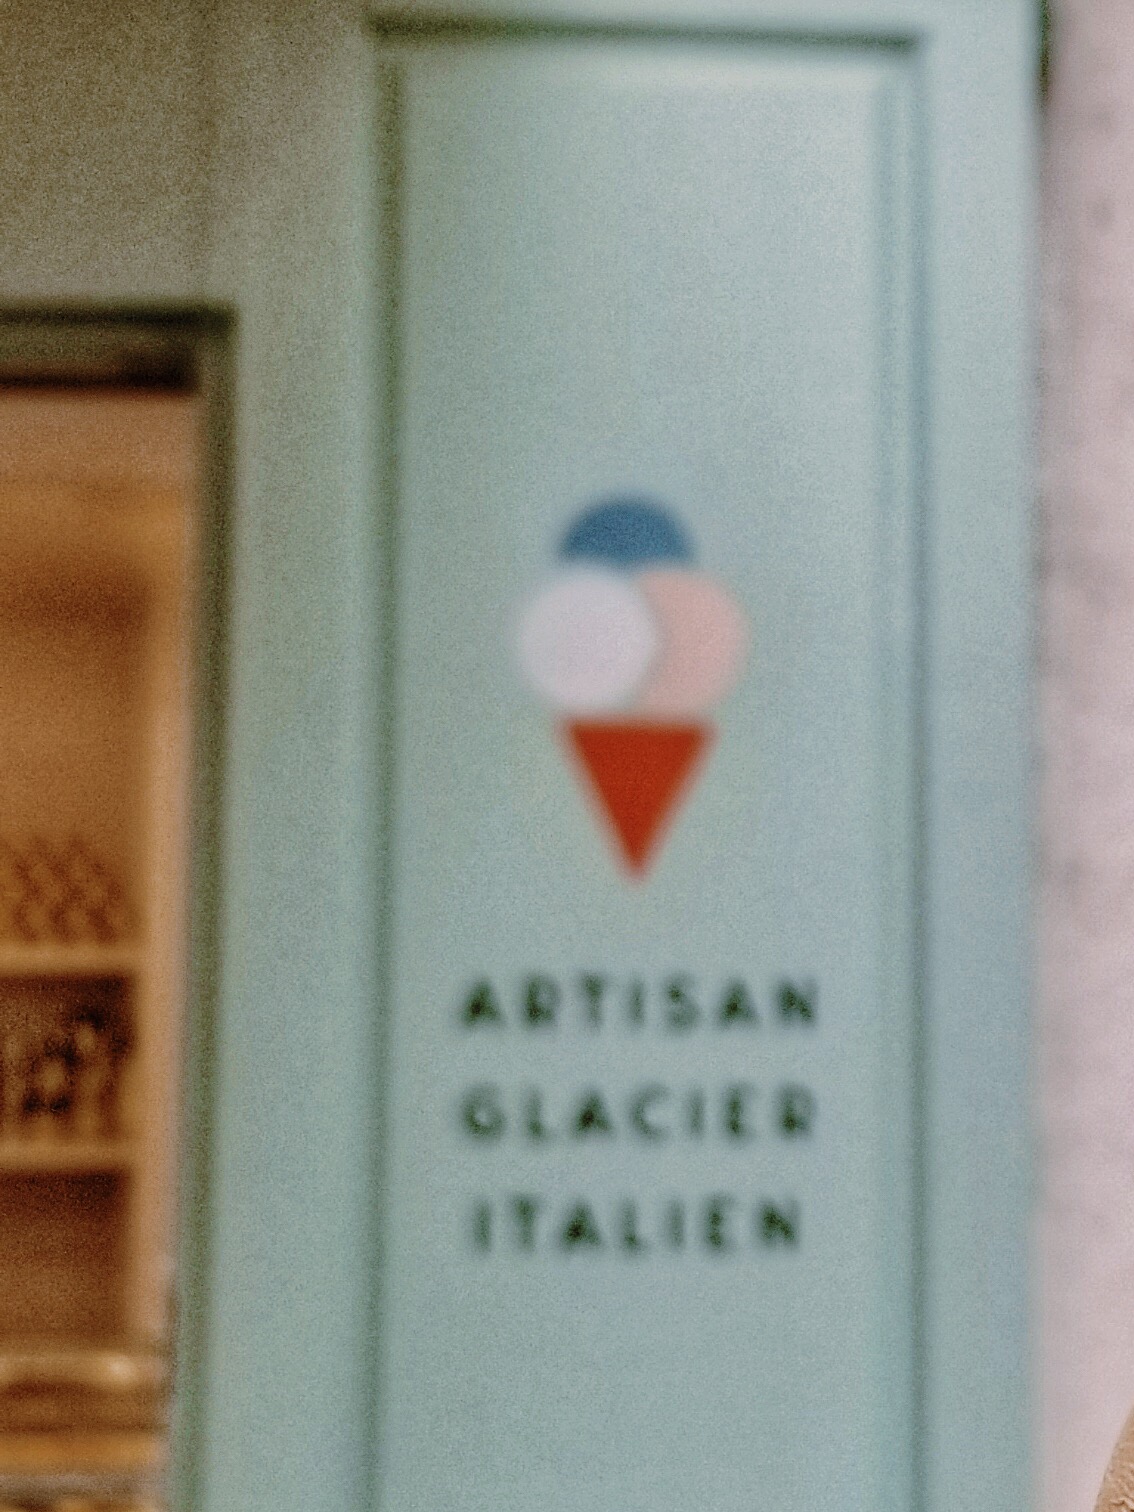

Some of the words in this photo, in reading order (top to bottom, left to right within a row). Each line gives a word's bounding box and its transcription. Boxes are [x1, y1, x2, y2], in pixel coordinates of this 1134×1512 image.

[461, 970, 819, 1033] ARTISAN
[461, 1083, 817, 1143] GLACIER
[472, 1194, 800, 1255] ITALIEN
